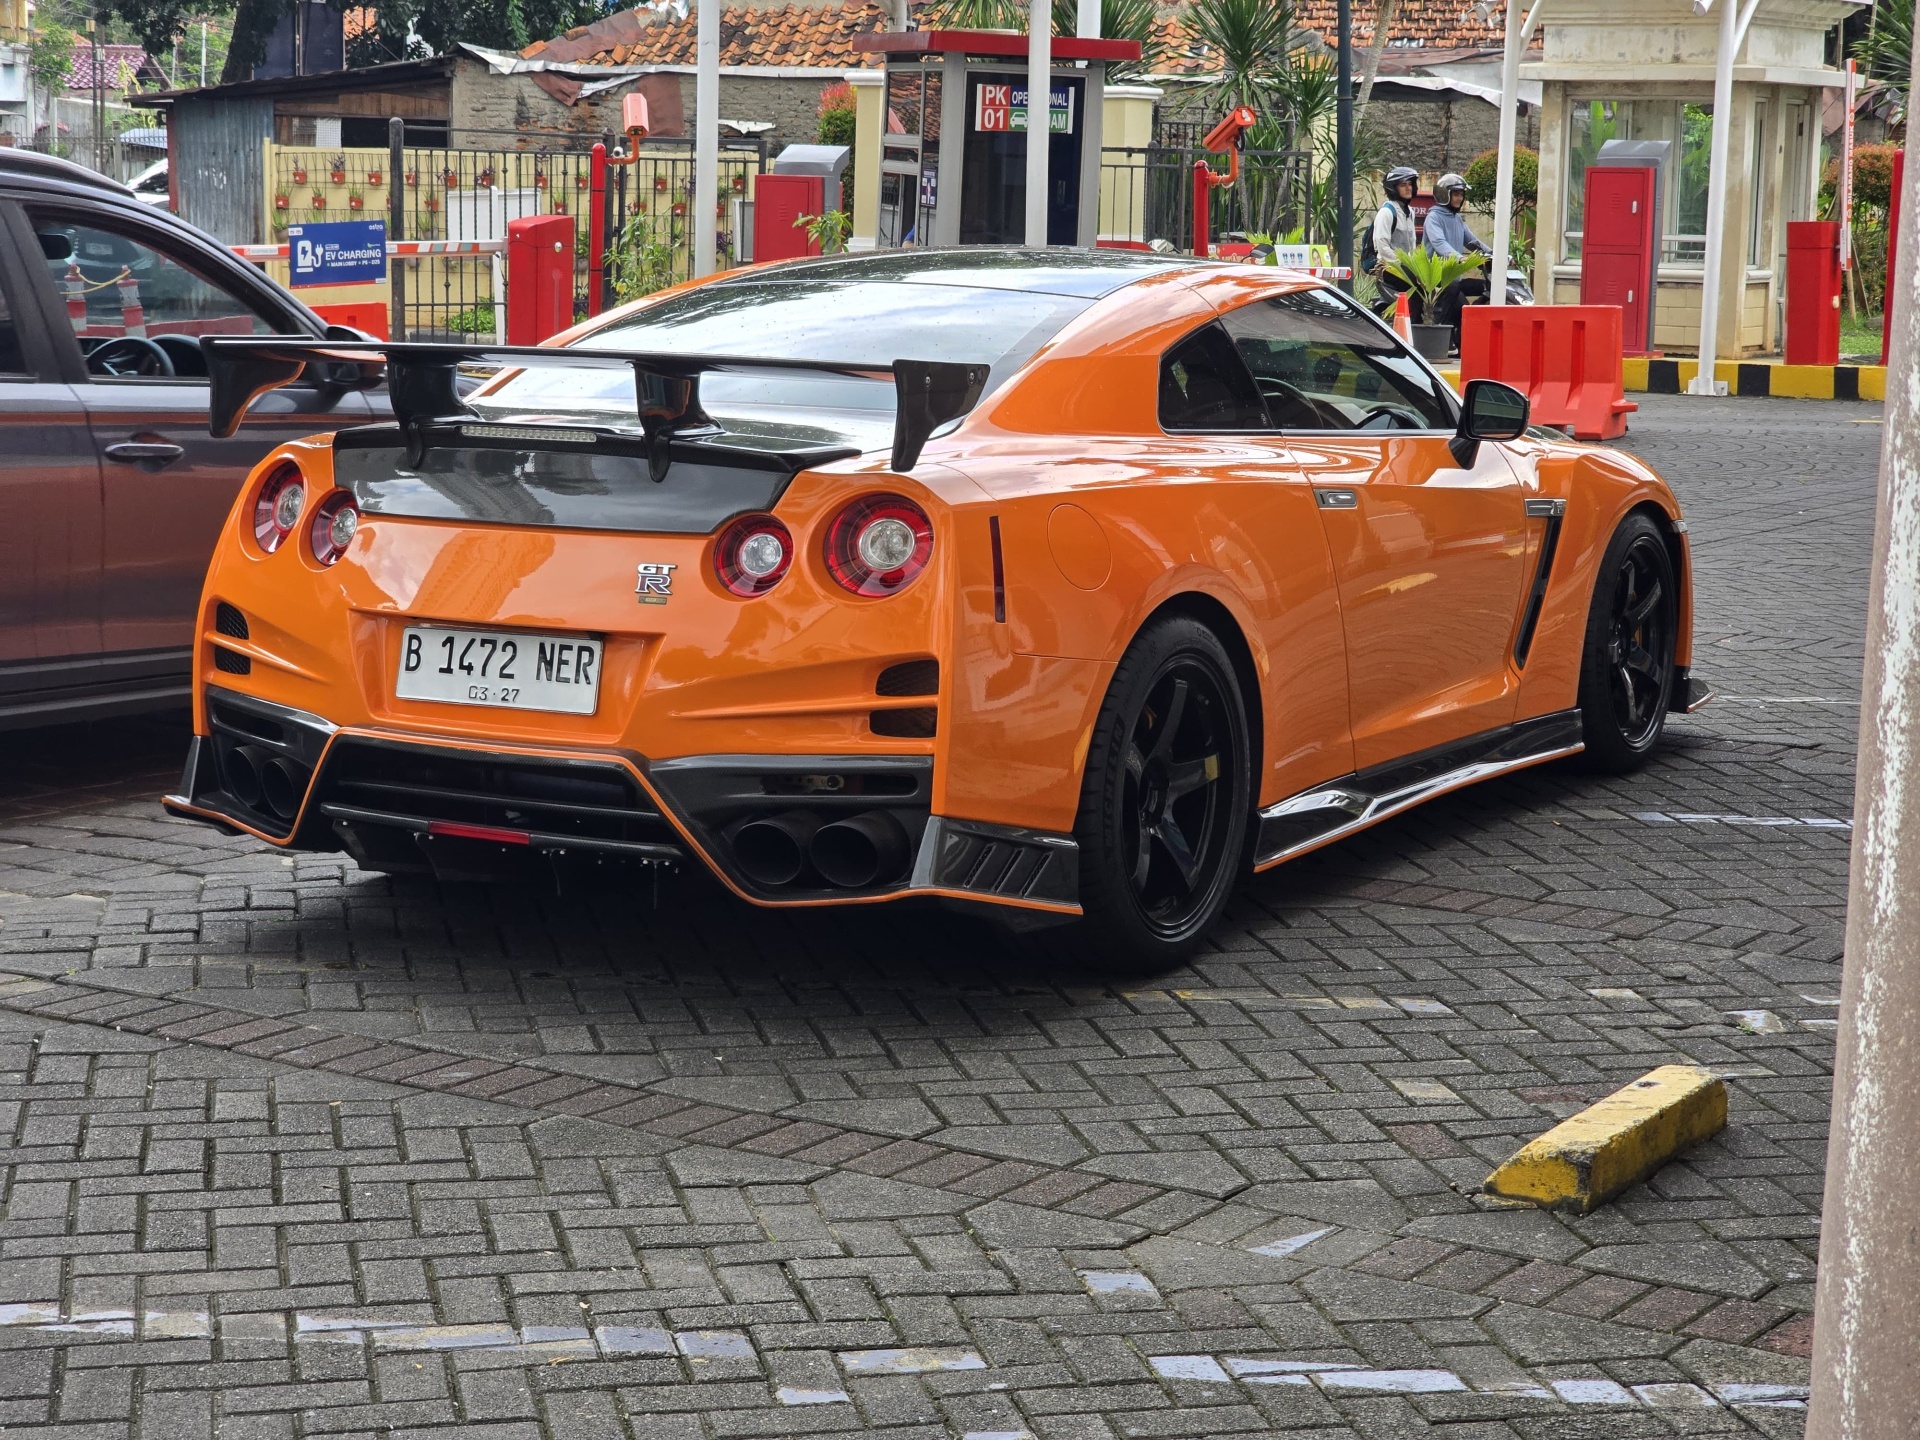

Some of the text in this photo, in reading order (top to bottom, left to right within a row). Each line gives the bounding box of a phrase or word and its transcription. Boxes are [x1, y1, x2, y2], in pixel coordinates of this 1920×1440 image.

[985, 86, 1007, 105] PK
[984, 108, 1004, 129] 01
[1049, 113, 1066, 129] AM
[325, 251, 336, 260] EV
[337, 248, 382, 260] CHARGING
[404, 633, 596, 685] B 1472 NER
[1103, 722, 1124, 848] MICHELIN
